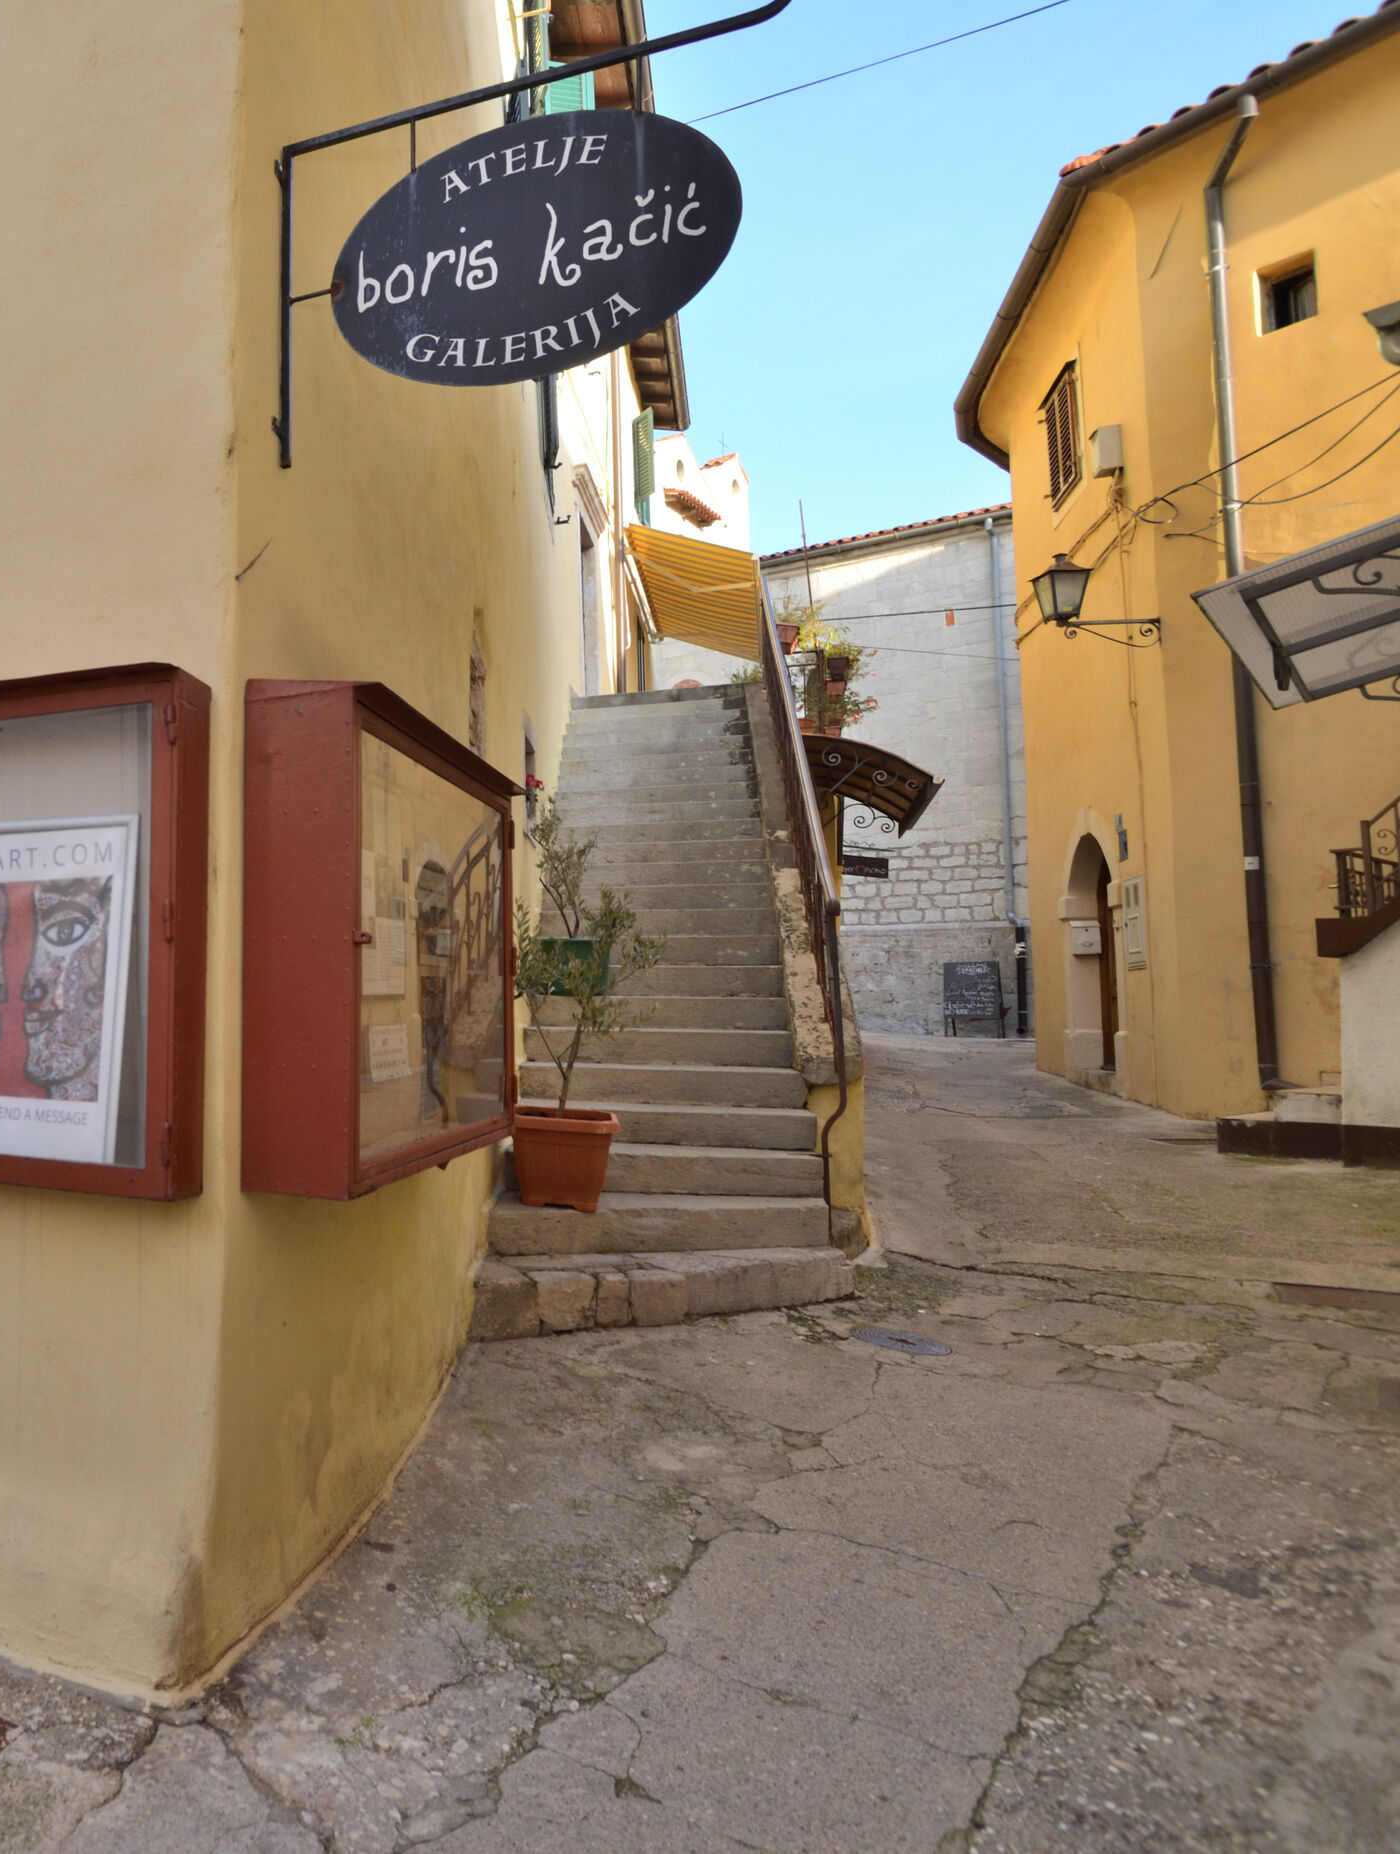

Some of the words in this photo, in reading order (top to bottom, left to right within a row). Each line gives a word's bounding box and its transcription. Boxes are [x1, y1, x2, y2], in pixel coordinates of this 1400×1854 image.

[440, 134, 608, 204] ATELJE
[356, 226, 498, 313] boris
[538, 182, 707, 287] kačić
[405, 291, 641, 368] GALERIJA
[23, 1108, 32, 1120] A
[34, 1109, 89, 1126] MESSAGE
